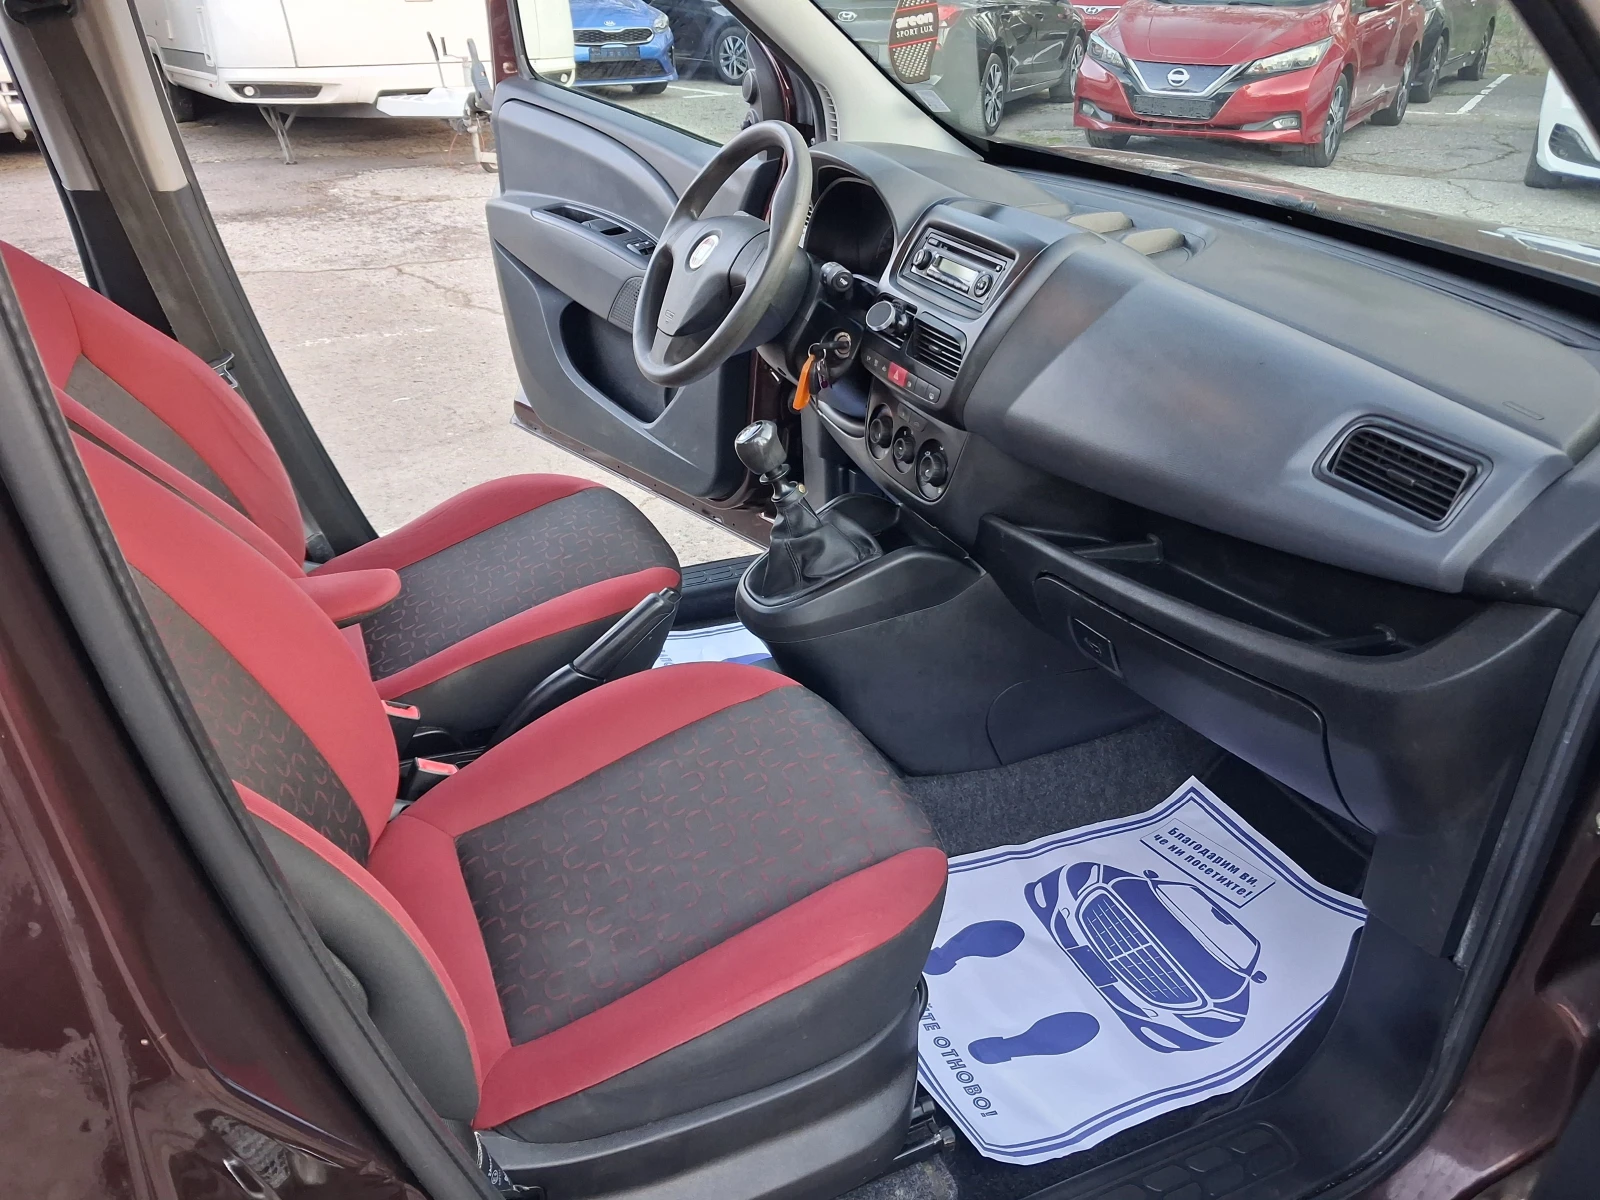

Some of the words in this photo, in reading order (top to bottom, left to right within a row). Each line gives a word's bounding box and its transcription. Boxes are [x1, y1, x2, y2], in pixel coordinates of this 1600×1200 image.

[895, 12, 934, 29] areon
[896, 28, 918, 38] SPORT
[920, 25, 934, 34] LUX
[1153, 834, 1169, 845] че
[1167, 844, 1186, 857] ни
[1184, 854, 1254, 898] посетихте!
[1167, 827, 1240, 875] Благодарим
[933, 1036, 998, 1118] ОТНОВО!
